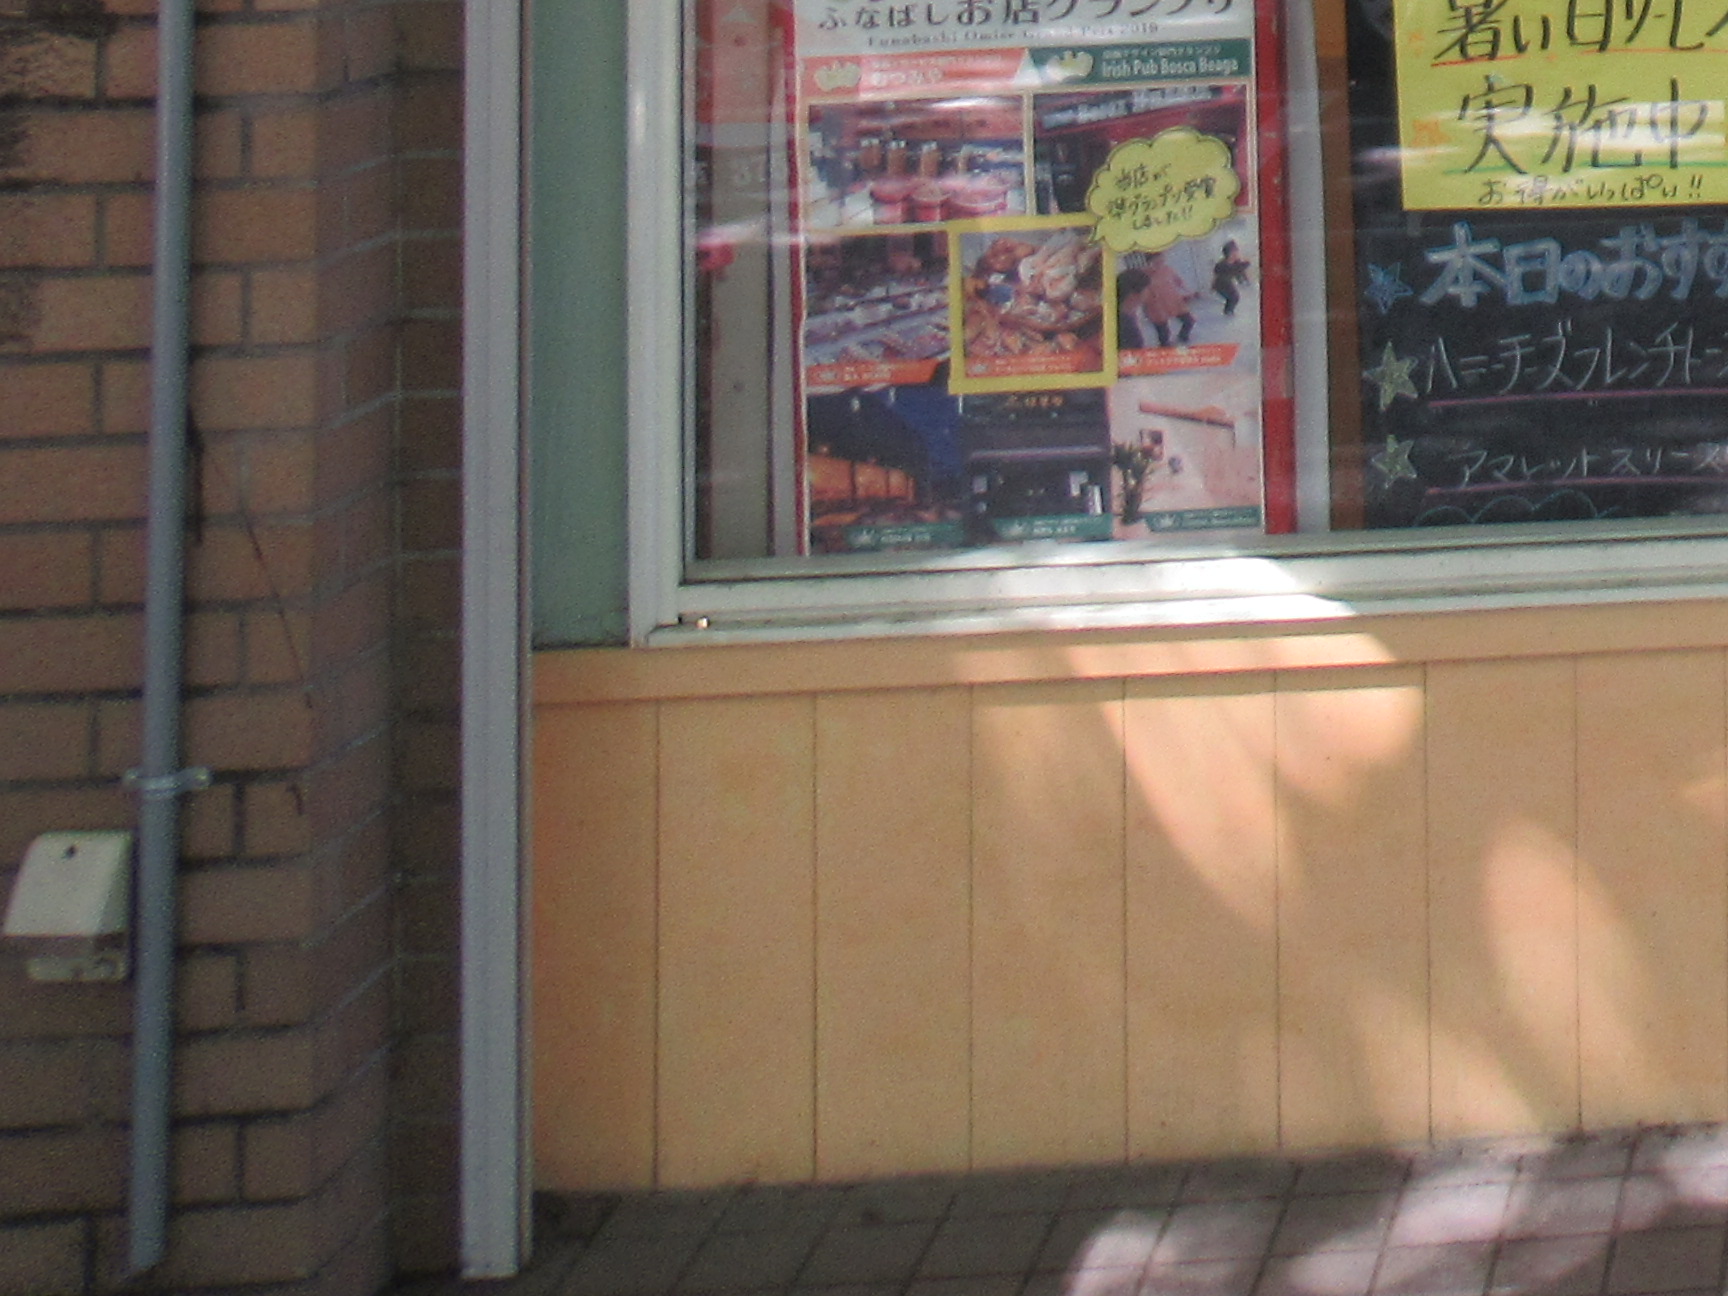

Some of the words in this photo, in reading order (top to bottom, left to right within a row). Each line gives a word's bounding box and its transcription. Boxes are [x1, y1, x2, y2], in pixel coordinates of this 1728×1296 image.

[1134, 59, 1158, 76] Pub
[1457, 74, 1710, 175] 実施中
